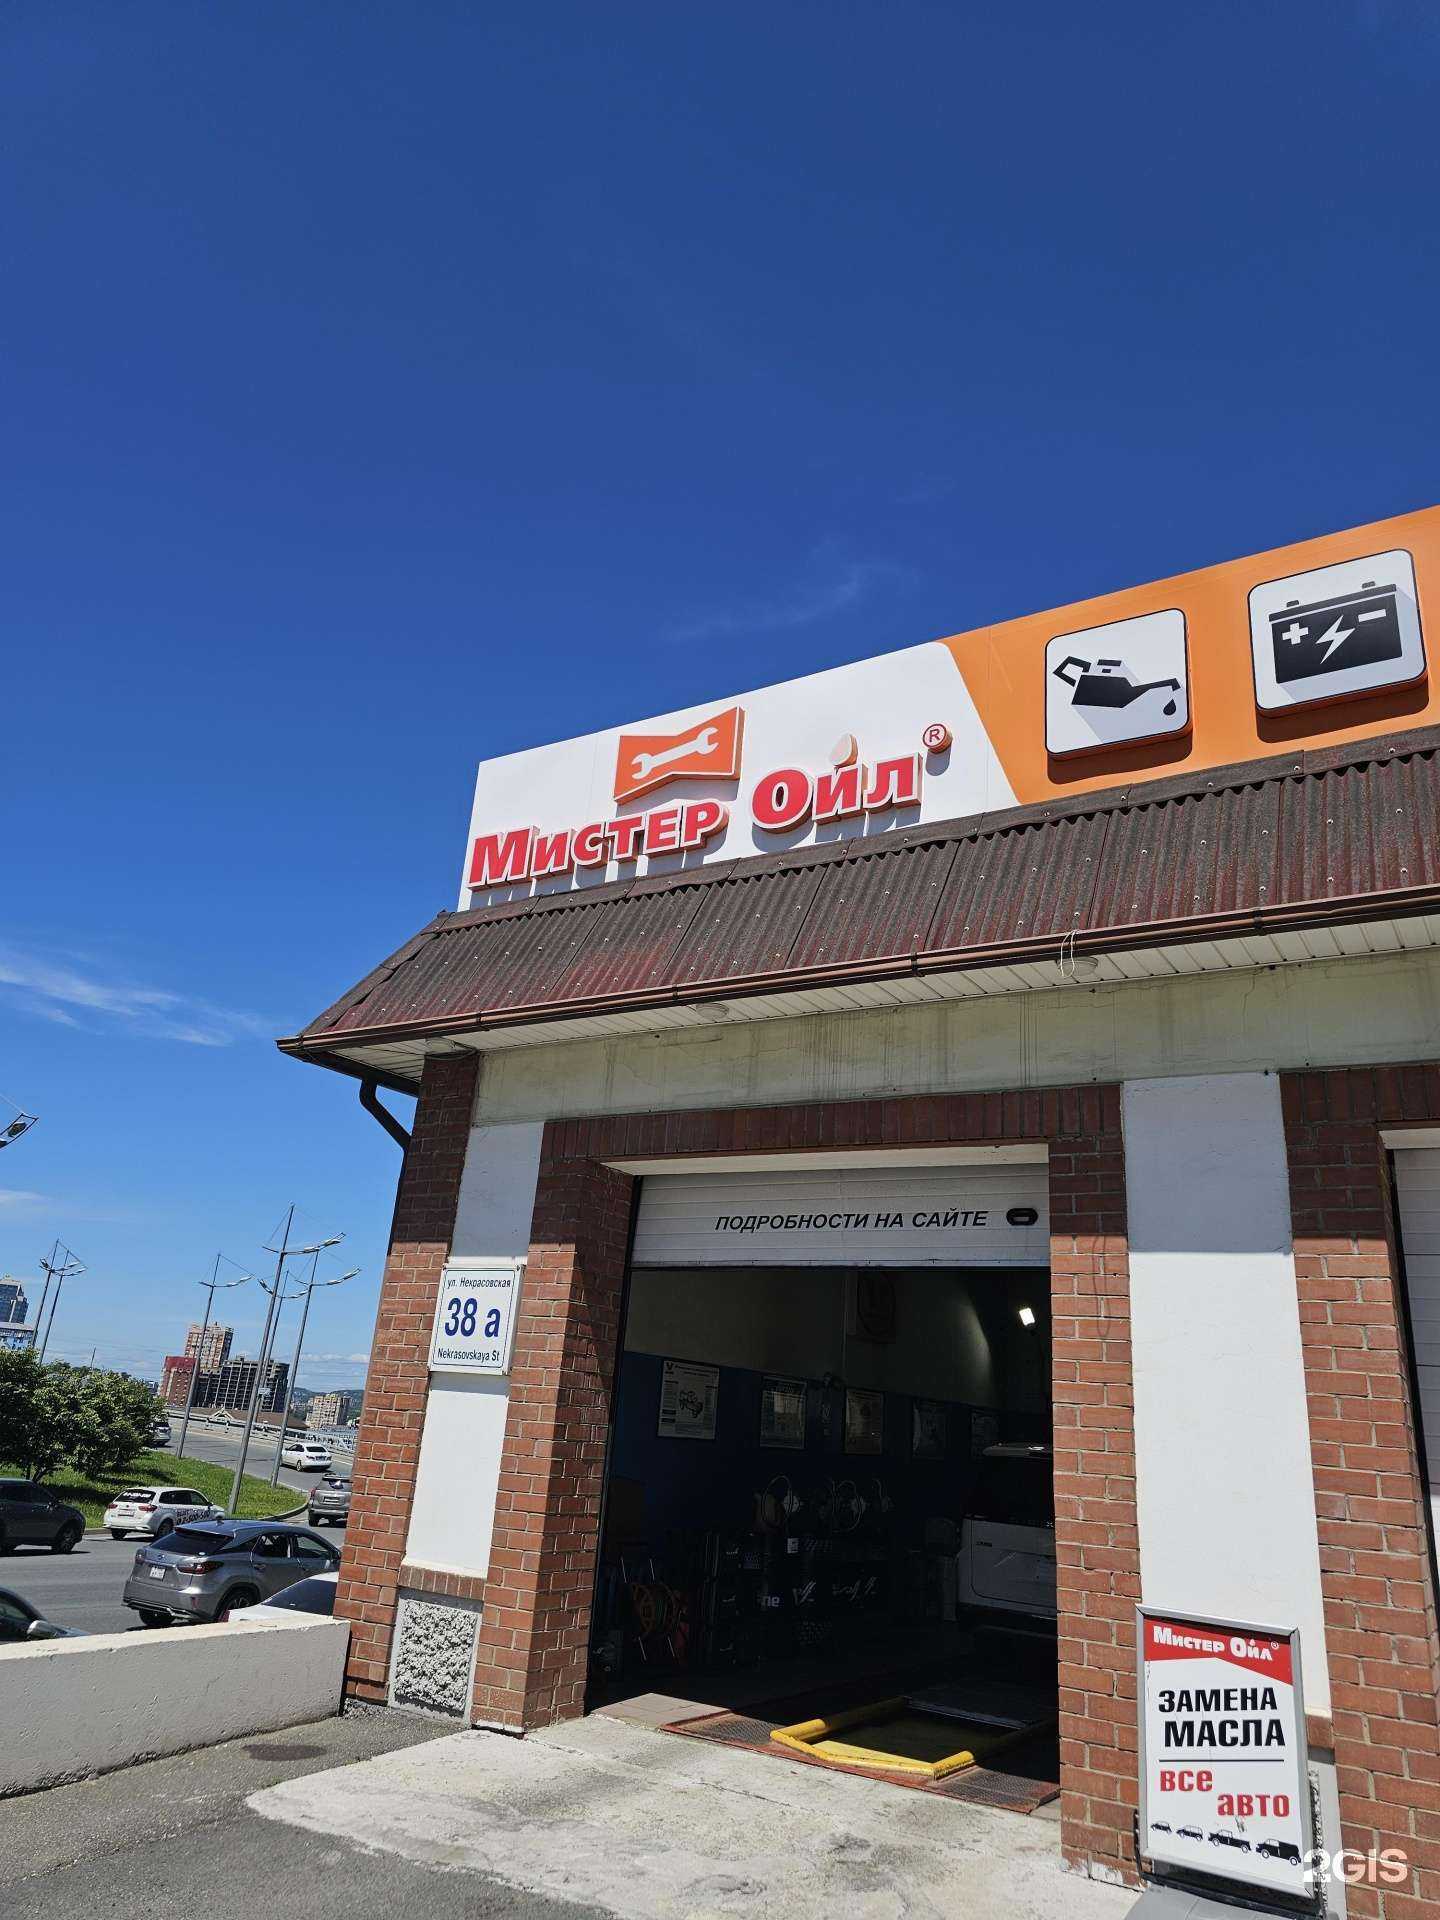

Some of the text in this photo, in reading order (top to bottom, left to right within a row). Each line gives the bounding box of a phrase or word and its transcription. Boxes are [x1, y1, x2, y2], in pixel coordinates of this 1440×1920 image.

[714, 1208, 989, 1233] ПОДРОБНОСТИ НА САЙТЕ
[447, 1277, 511, 1289] ул. Некрасовская
[444, 1297, 478, 1337] 38
[438, 1348, 490, 1363] Nekrasovskaya
[1158, 1687, 1278, 1713] ЗАМЕНА
[1163, 1719, 1286, 1748] МАСЛА
[1217, 1794, 1290, 1818] авто
